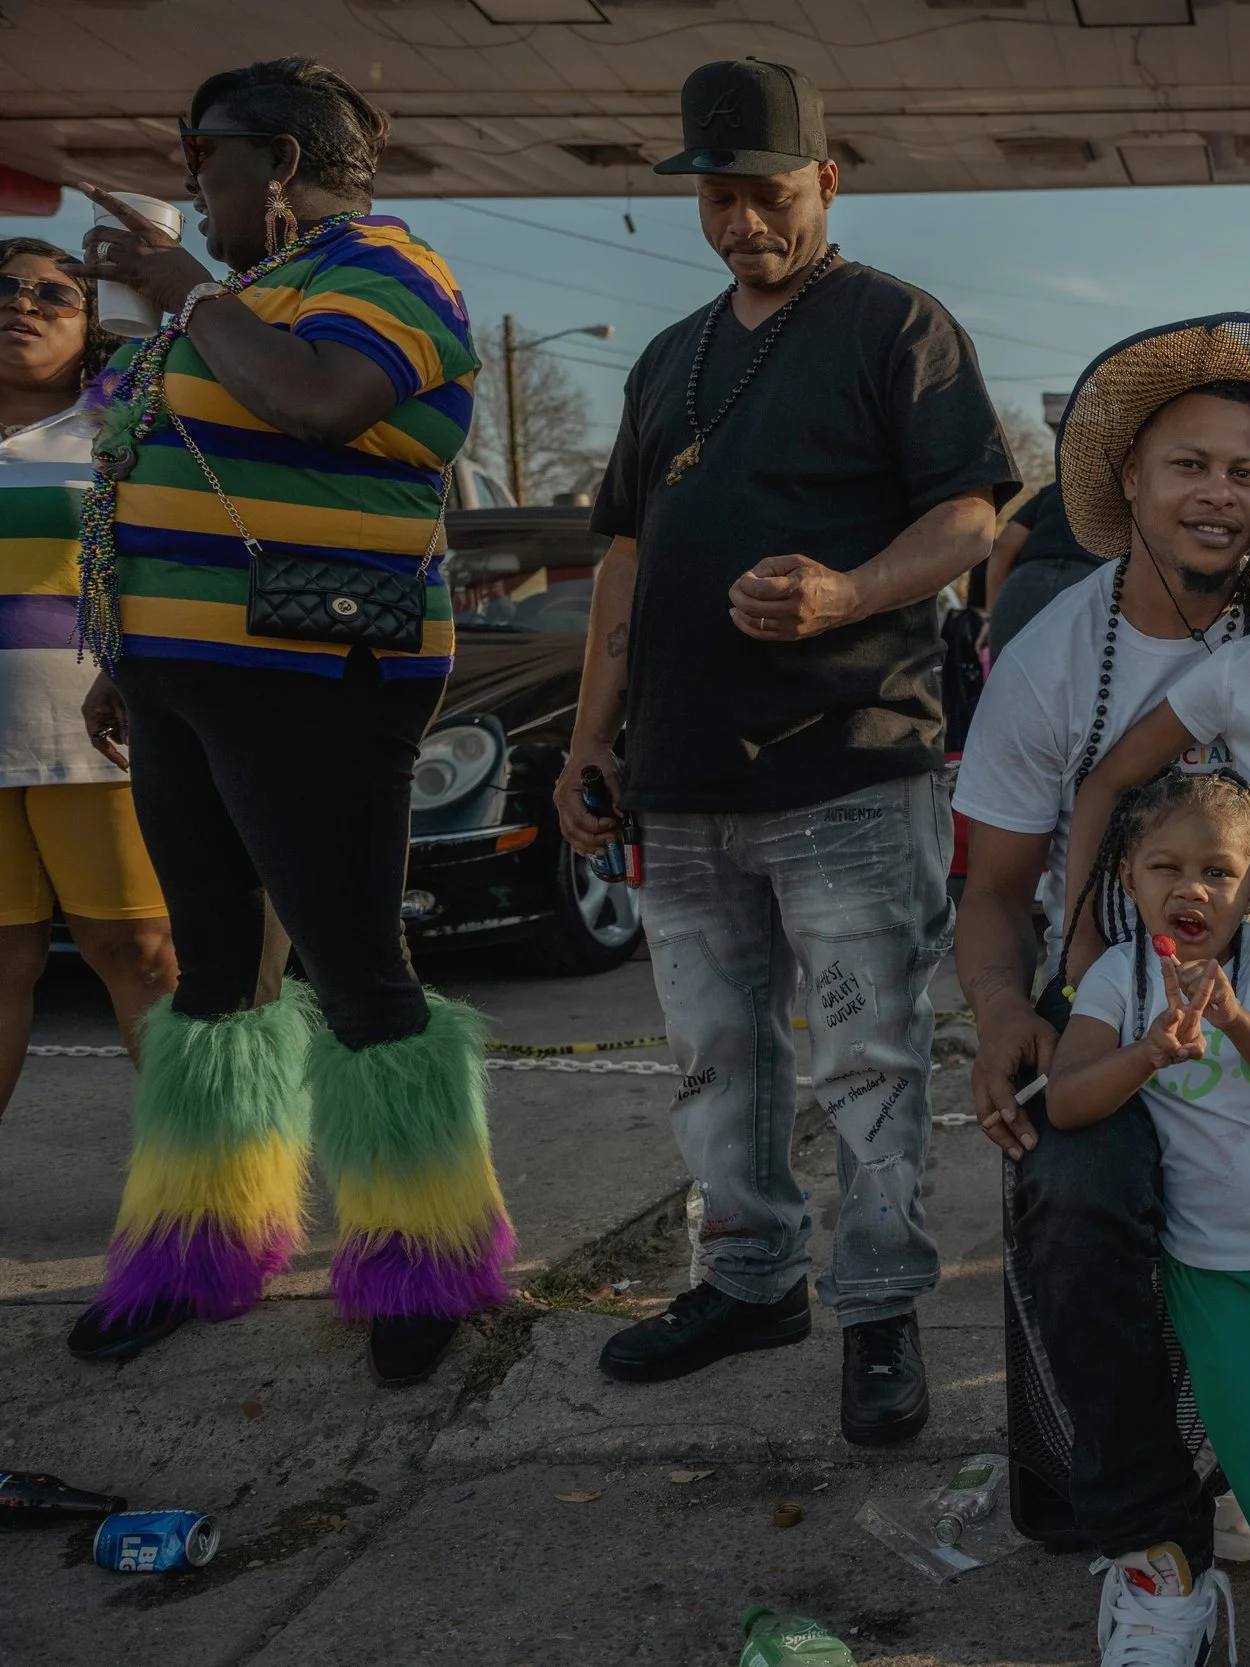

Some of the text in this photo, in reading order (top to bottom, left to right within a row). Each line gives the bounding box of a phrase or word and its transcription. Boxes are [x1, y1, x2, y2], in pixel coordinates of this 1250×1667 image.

[824, 808, 883, 822] AUTHENTIC
[821, 972, 860, 1009] QUALITY
[826, 992, 867, 1028] COUTURE
[826, 1096, 847, 1119] gher
[847, 1071, 886, 1102] standard
[864, 1075, 909, 1143] uncomplicated
[785, 1630, 824, 1645] Sprite
